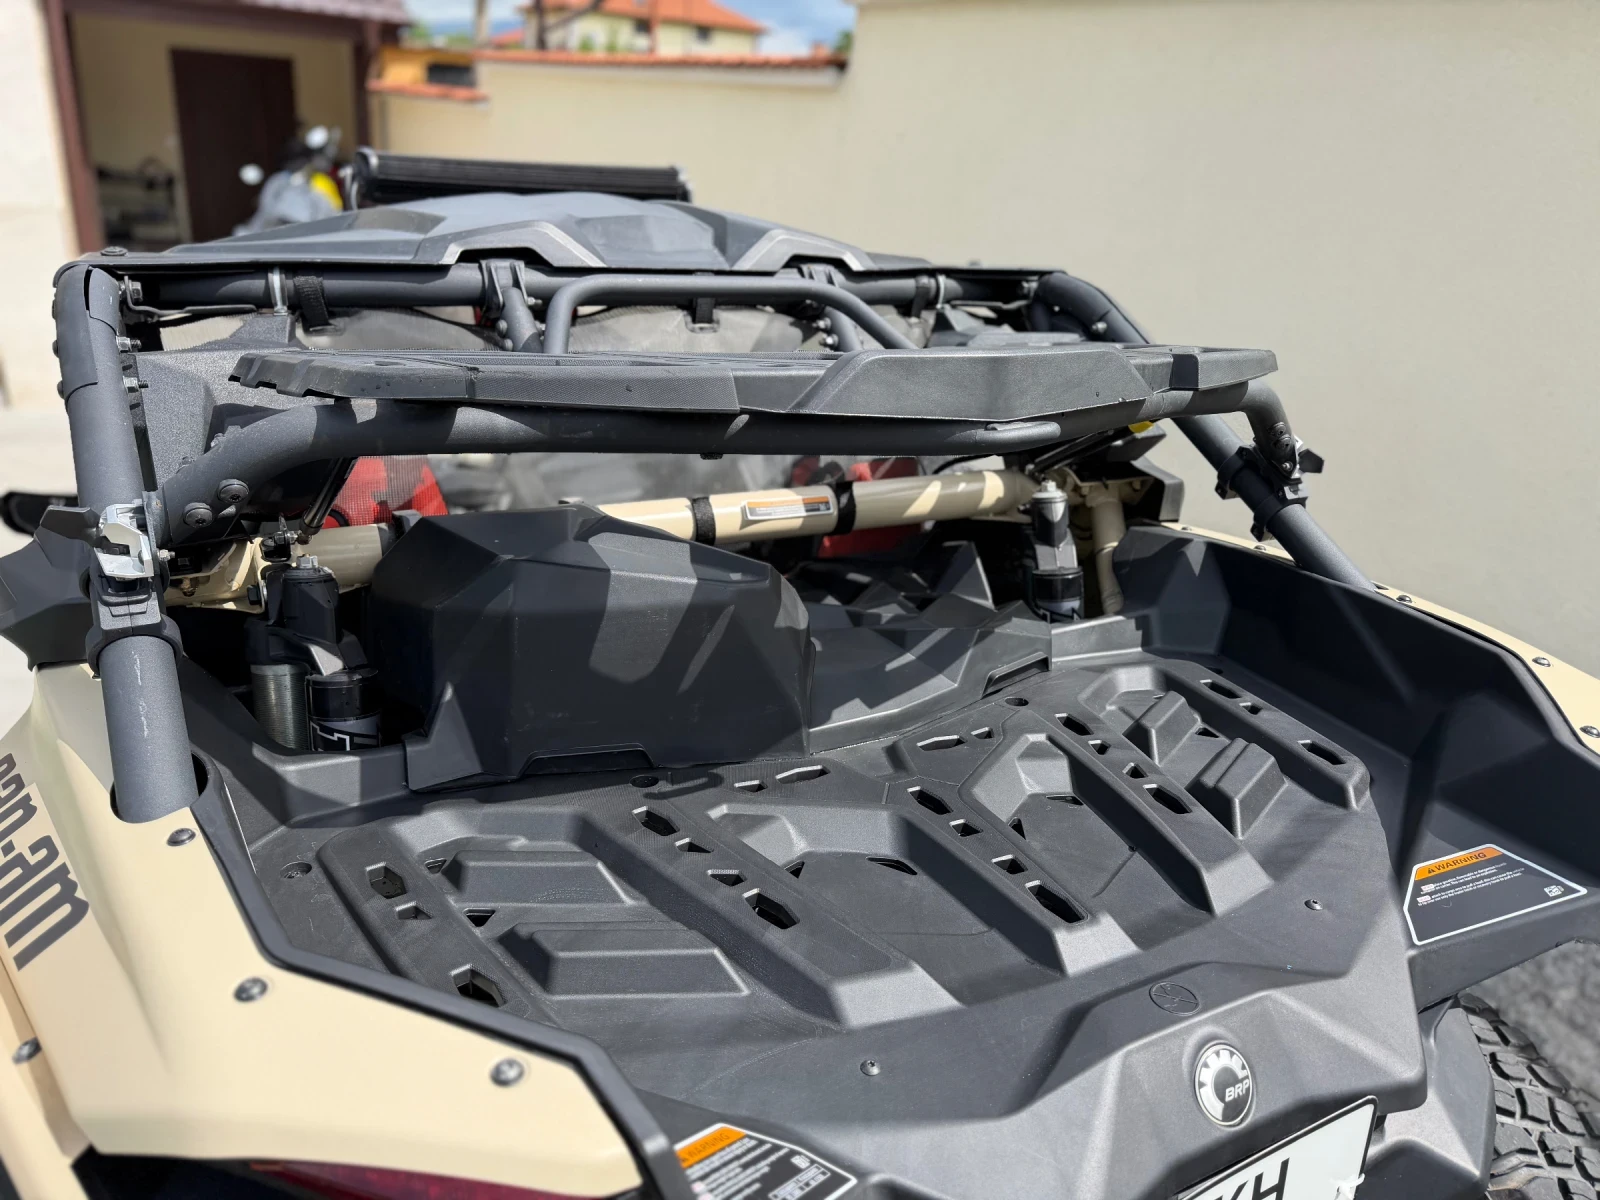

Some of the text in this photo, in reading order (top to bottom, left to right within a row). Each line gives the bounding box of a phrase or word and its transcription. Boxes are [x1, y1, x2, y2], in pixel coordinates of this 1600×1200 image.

[1435, 852, 1487, 871] WARNING
[1225, 1079, 1250, 1102] BRP
[688, 1132, 730, 1160] WARNING
